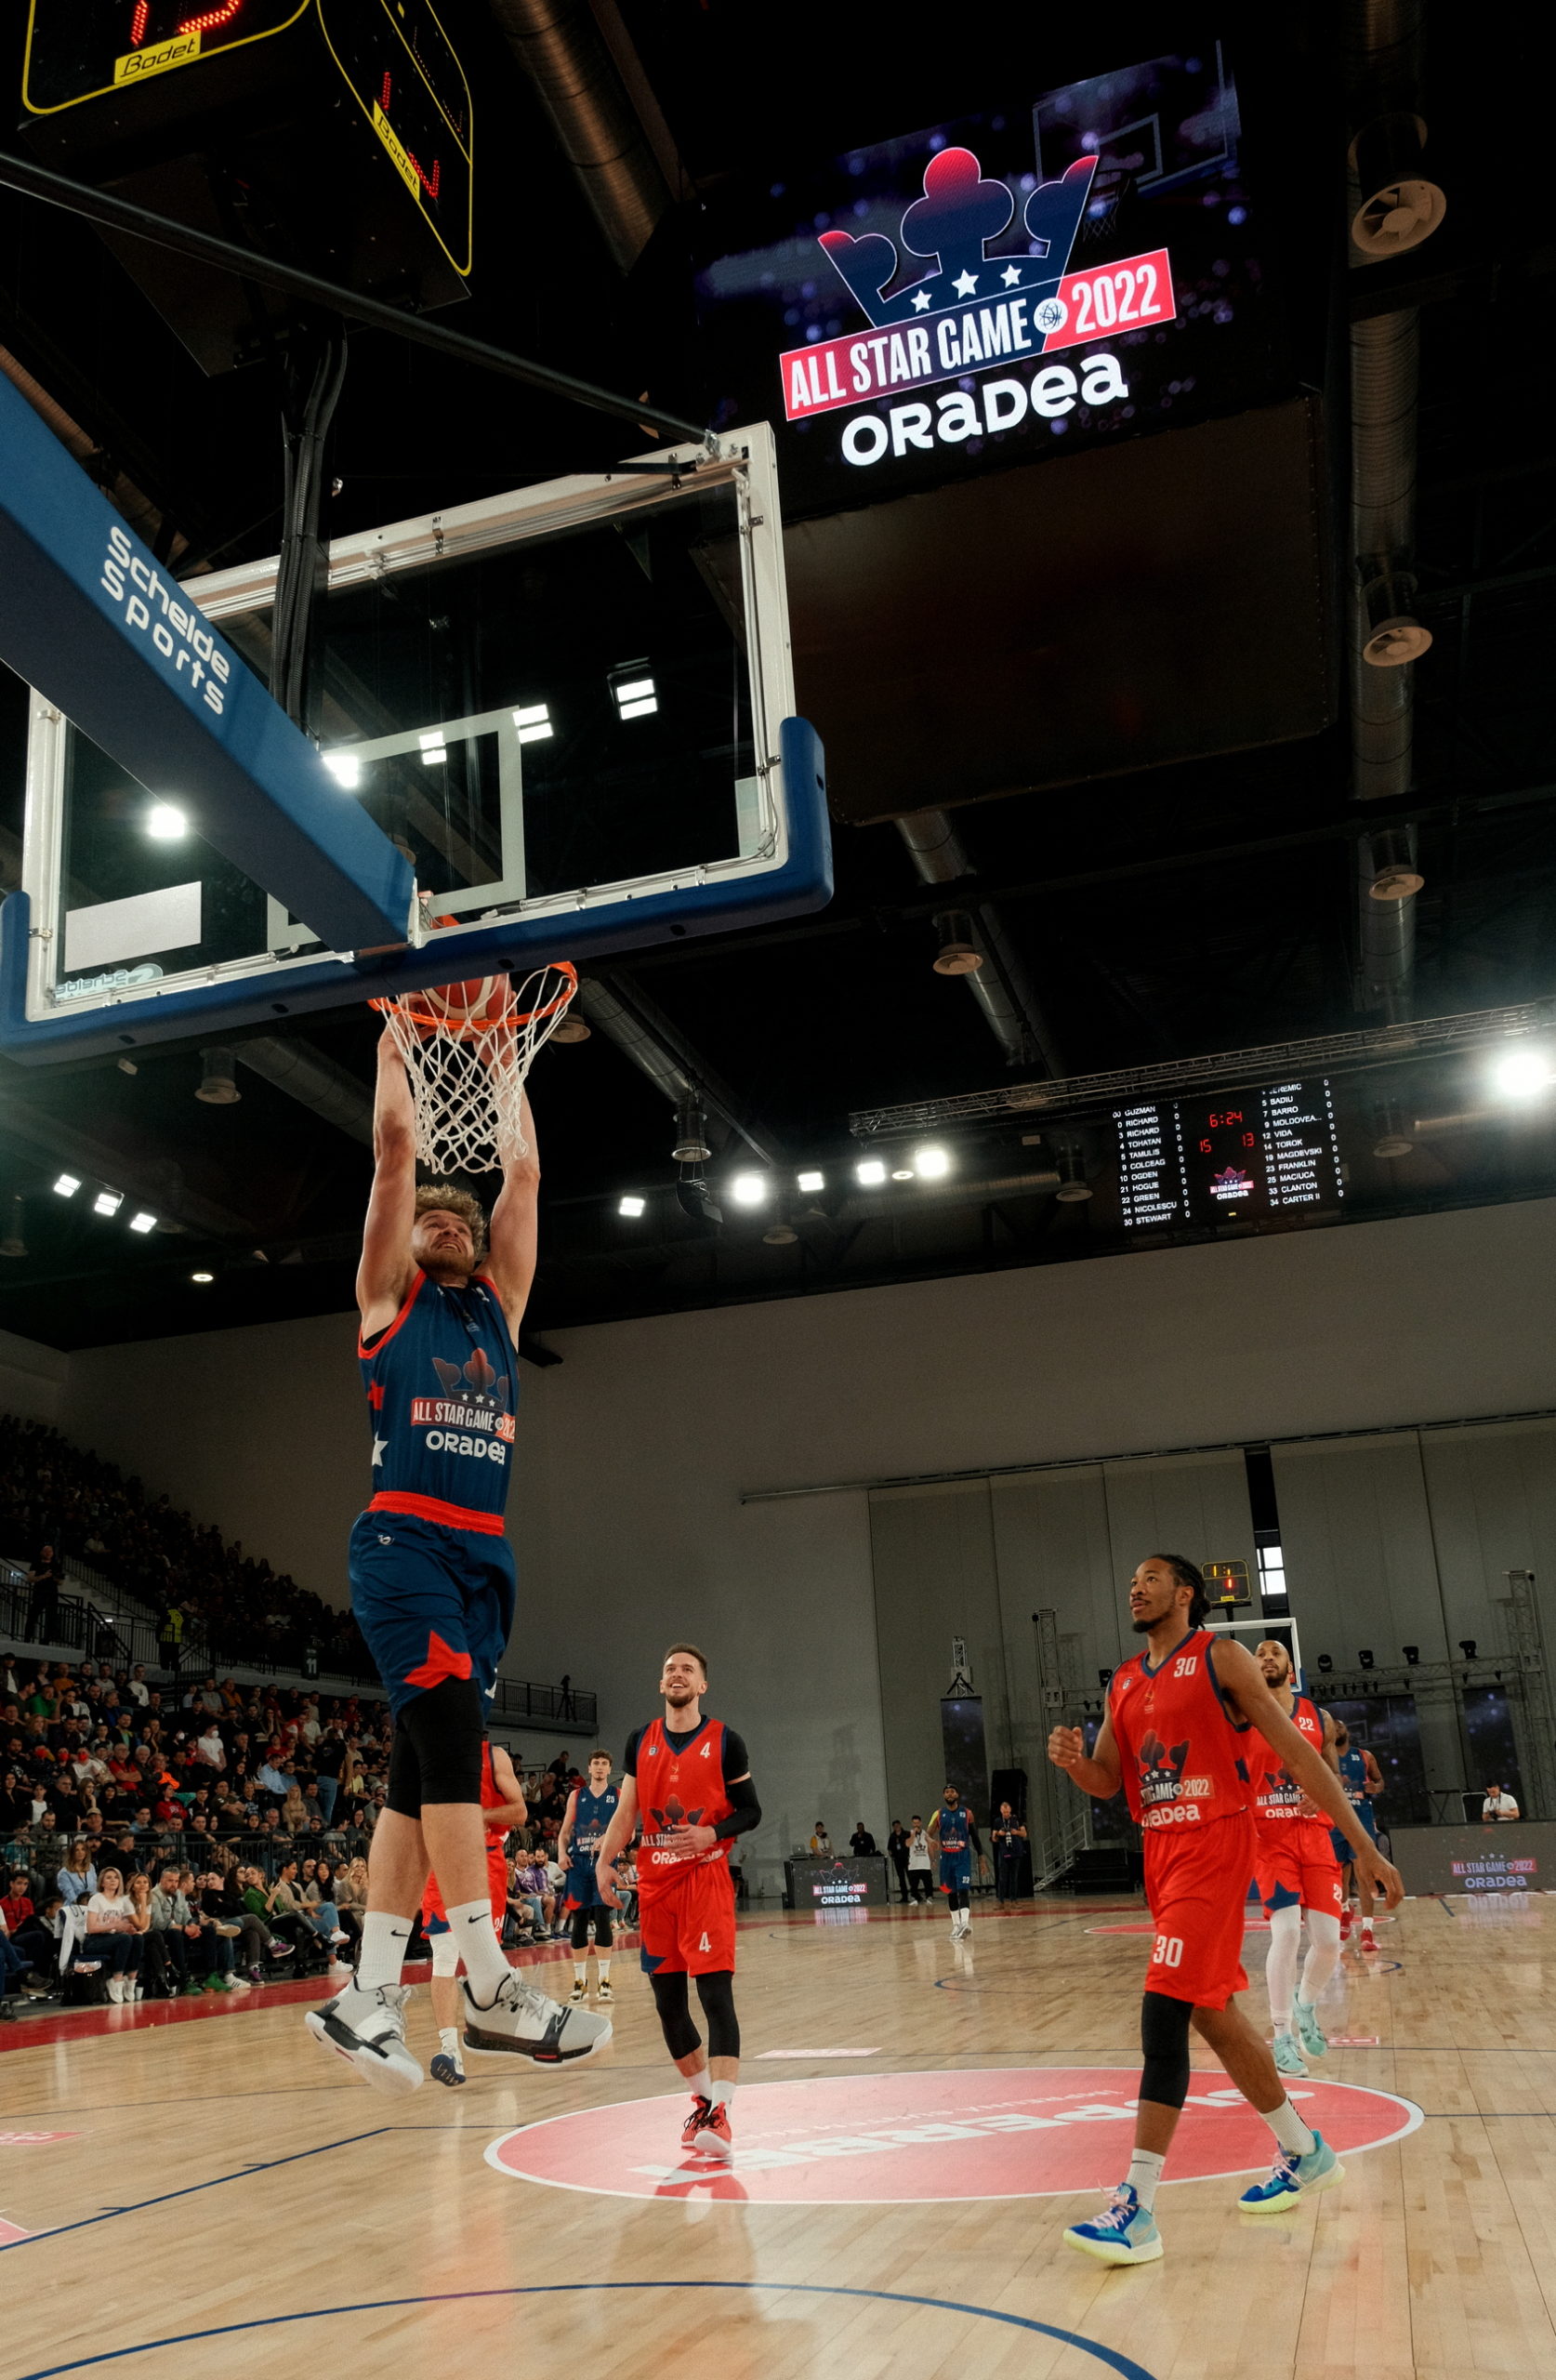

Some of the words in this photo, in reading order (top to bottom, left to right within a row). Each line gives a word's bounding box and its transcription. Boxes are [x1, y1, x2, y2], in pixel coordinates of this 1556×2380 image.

[120, 38, 196, 78] Bodet
[376, 115, 418, 192] Bodet
[790, 350, 847, 410] ALL
[850, 327, 932, 393] STAR
[937, 298, 1032, 370] GAME
[1072, 264, 1161, 335] 2022
[107, 526, 230, 684] Schelde
[1125, 1106, 1156, 1116] GUZMAN
[1272, 1106, 1298, 1116] BARRO
[1126, 1116, 1159, 1127] RICHARD
[1209, 1111, 1242, 1128] 6:24
[1127, 1127, 1160, 1138] RICHARD
[1274, 1129, 1292, 1138] VIDA
[1128, 1138, 1162, 1148] TOHATAN
[1243, 1132, 1254, 1147] 13
[1276, 1139, 1303, 1149] TOROK
[1200, 1139, 1212, 1153] 15
[1129, 1149, 1160, 1159] TAMULIS
[1277, 1147, 1322, 1160] MAGDEVSKI
[1279, 1160, 1316, 1171] FRANKLIN
[1131, 1171, 1158, 1180] OGDEN
[1133, 1182, 1159, 1191] HOGUE
[1281, 1182, 1318, 1193] CLANTON
[1134, 1193, 1160, 1202] GREEN
[1283, 1194, 1314, 1204] CARTER
[1135, 1201, 1177, 1213] NICOLESCU
[1136, 1213, 1171, 1224] STEWART
[413, 1402, 432, 1421] ALL
[435, 1402, 465, 1430] STAR
[466, 1407, 494, 1432] GAME
[1173, 1656, 1197, 1678] 30
[1299, 1716, 1315, 1732] 22
[700, 1742, 710, 1759] 4
[1184, 1779, 1210, 1797] 2022
[1256, 1795, 1268, 1806] ALL
[1269, 1794, 1283, 1805] STAR
[641, 1835, 656, 1847] ALL
[1453, 1863, 1466, 1874] ALL
[1467, 1862, 1485, 1873] STAR
[1486, 1861, 1507, 1872] GAME
[699, 1931, 712, 1952] 4
[1153, 1935, 1183, 1968] 30
